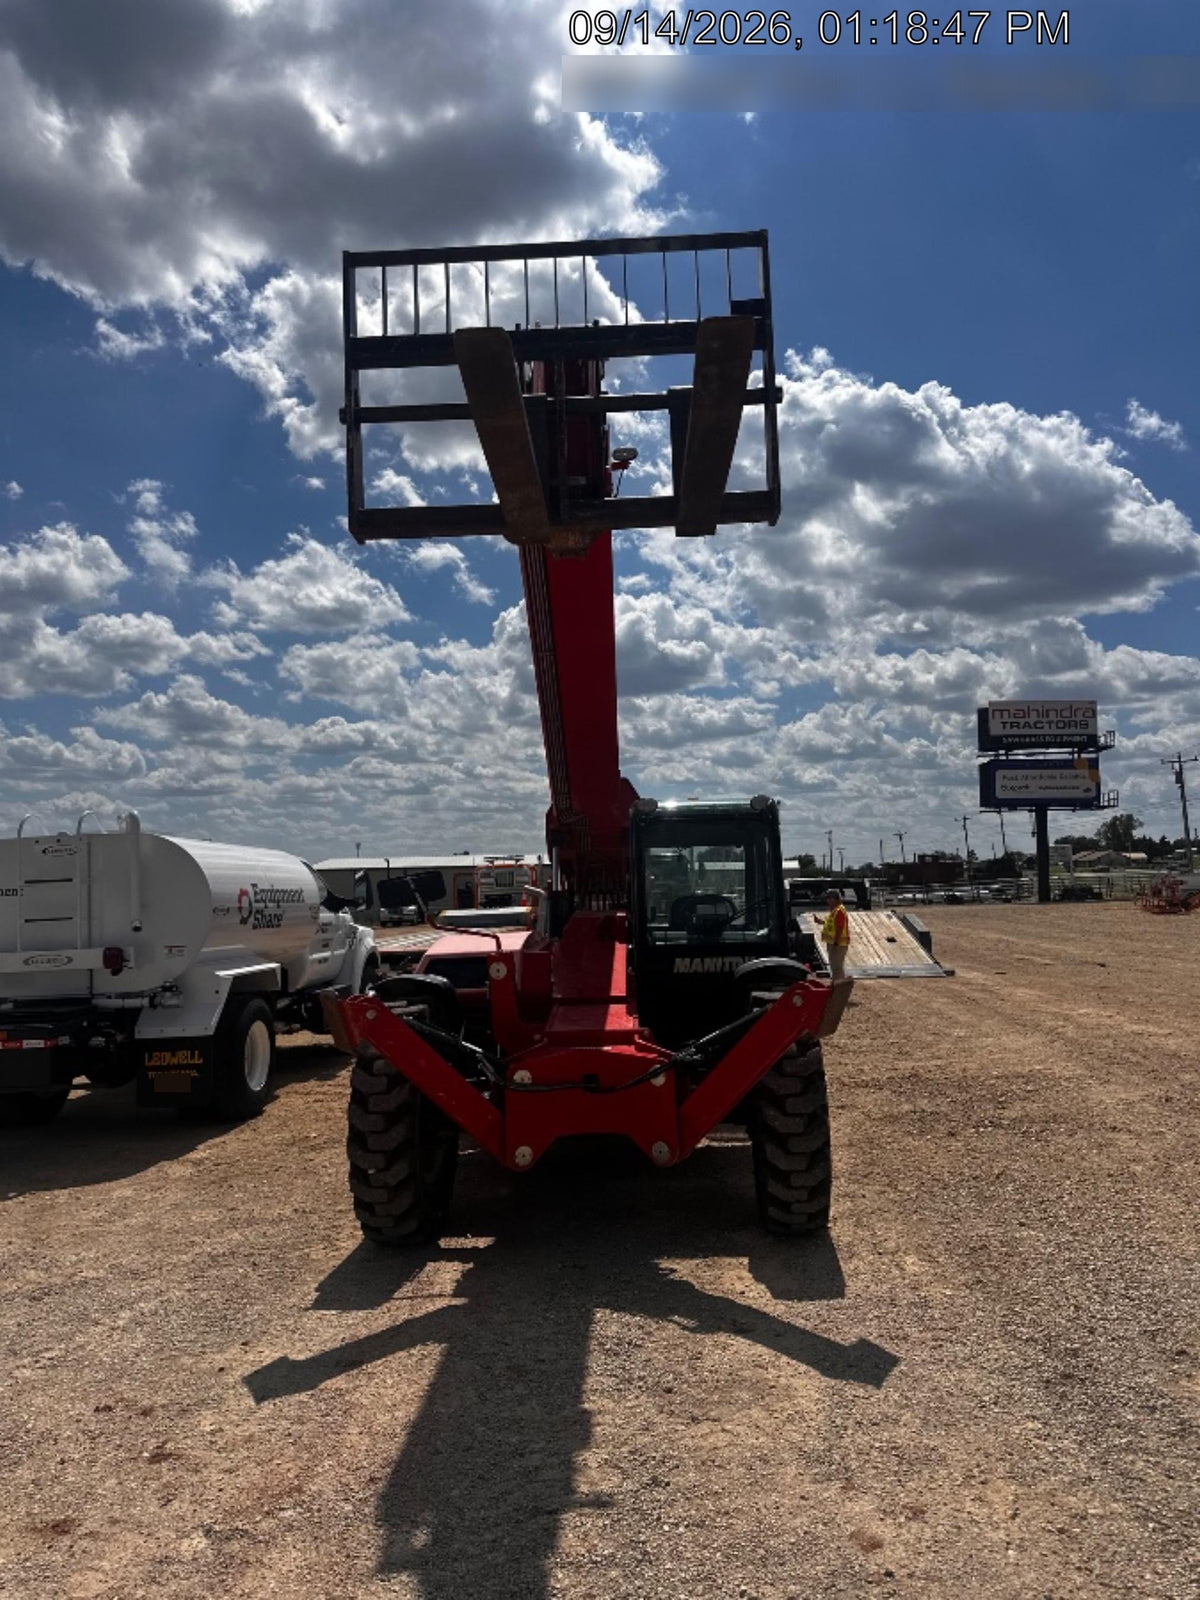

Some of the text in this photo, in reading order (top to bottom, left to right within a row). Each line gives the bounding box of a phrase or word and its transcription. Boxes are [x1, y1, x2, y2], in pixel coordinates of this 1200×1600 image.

[991, 705, 1096, 719] mahindra
[1000, 720, 1089, 730] TRACTORS
[252, 908, 283, 930] Share
[145, 1050, 203, 1066] LEDWELL
